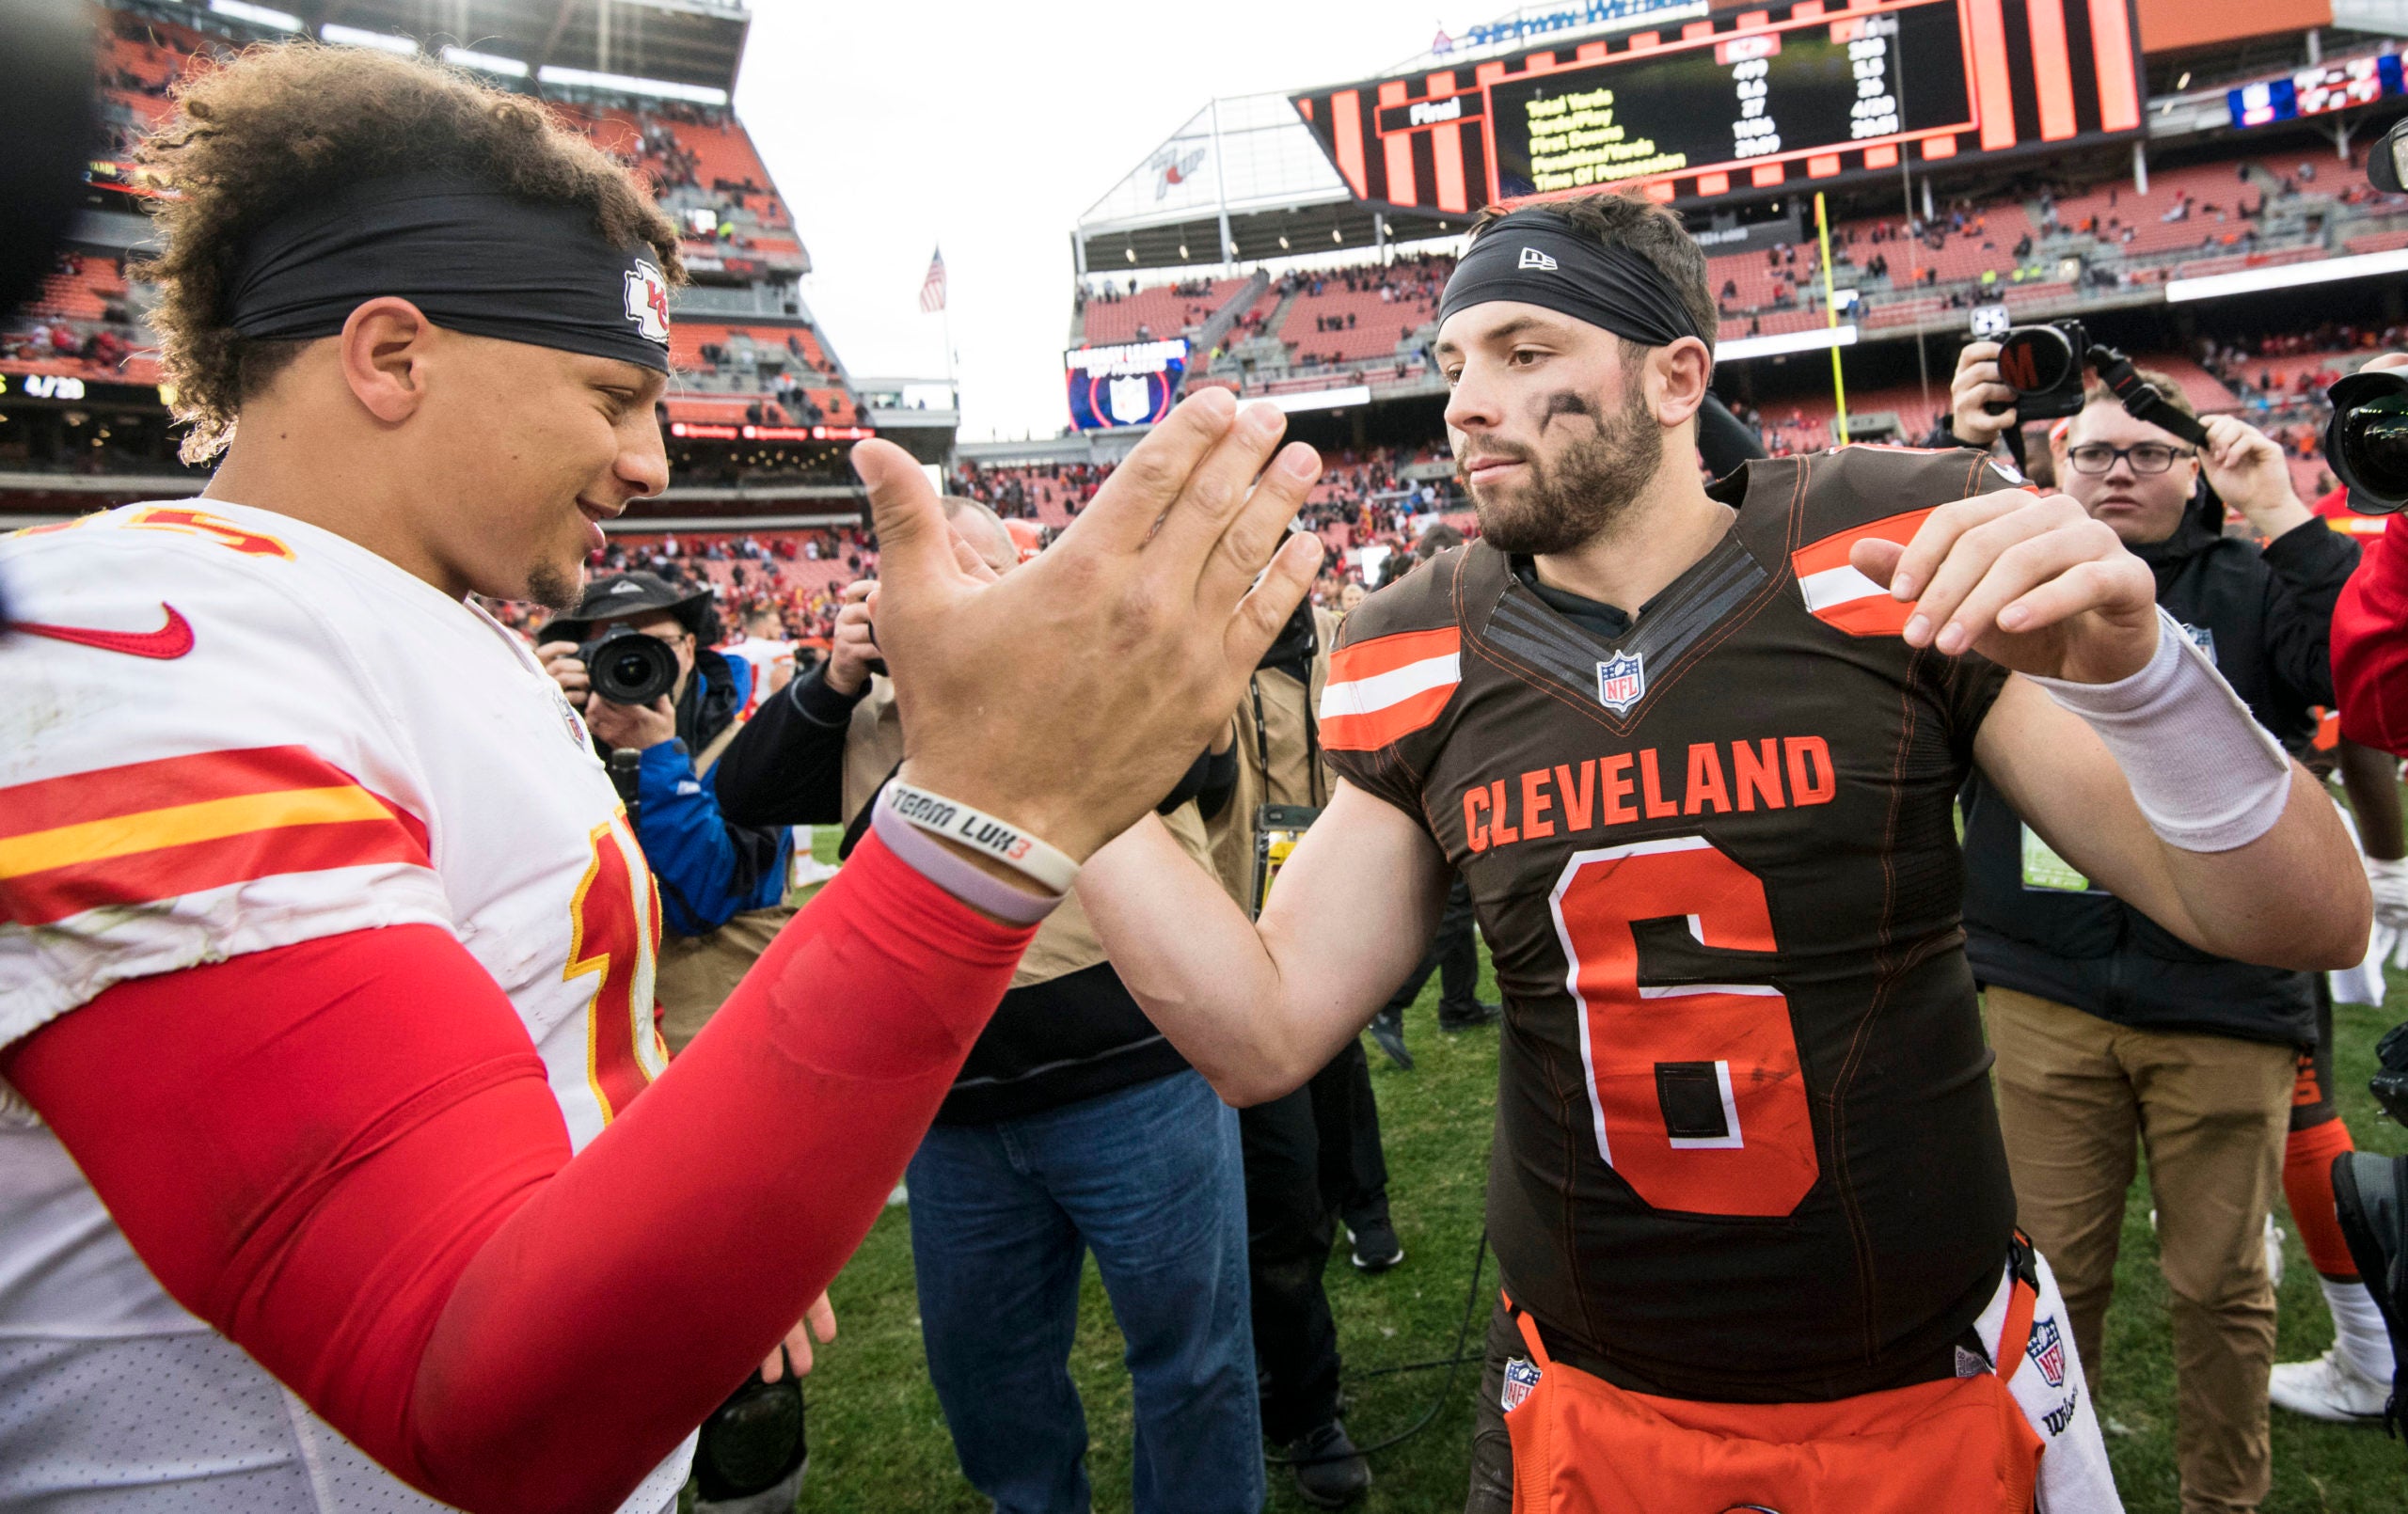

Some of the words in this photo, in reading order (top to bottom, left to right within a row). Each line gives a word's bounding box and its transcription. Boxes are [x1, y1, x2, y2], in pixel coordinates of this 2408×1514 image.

[1410, 96, 1461, 126] Final
[1525, 94, 1567, 118] Total
[1567, 87, 1613, 111] Yards
[1529, 134, 1568, 155] First
[1568, 125, 1624, 149] Downs
[1532, 172, 1573, 192] Time
[1594, 152, 1687, 181] Possession
[1606, 676, 1638, 701] NFL
[1463, 735, 1836, 853] CLEVELAND
[892, 788, 958, 828] TEAM
[958, 815, 1033, 861] LUK3
[1547, 835, 1820, 1219] 6
